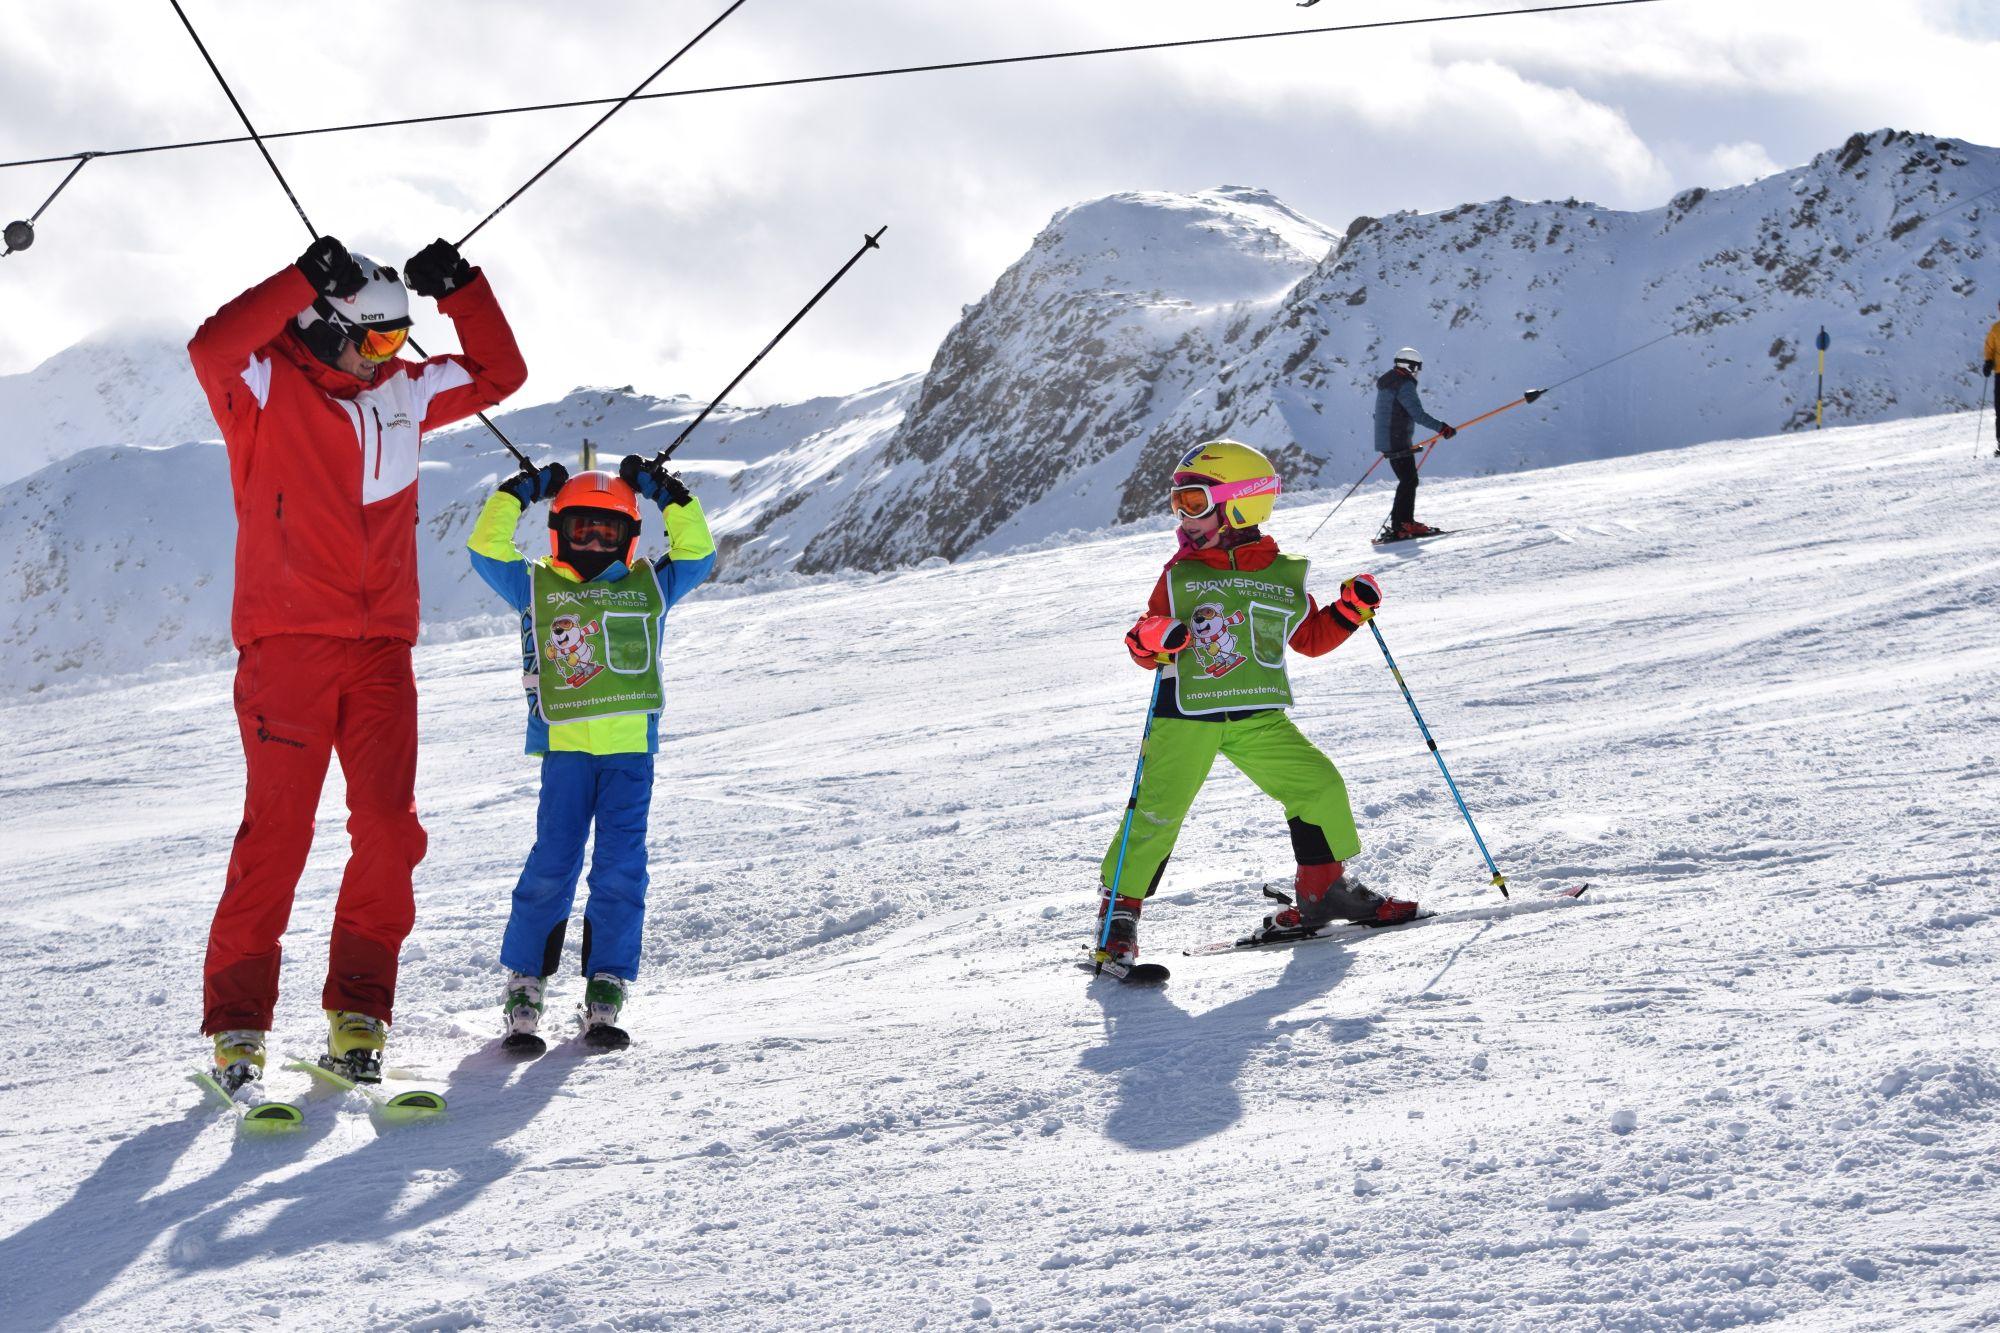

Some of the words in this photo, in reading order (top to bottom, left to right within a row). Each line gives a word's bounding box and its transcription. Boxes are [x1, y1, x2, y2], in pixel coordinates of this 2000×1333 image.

[361, 313, 385, 321] bern
[1232, 478, 1268, 499] HEAD
[1185, 578, 1295, 597] SNOWSPORTS
[546, 588, 648, 604] SNOWSPORTS
[593, 599, 648, 607] WESTENDORF
[1237, 589, 1295, 605] WESTENDORF
